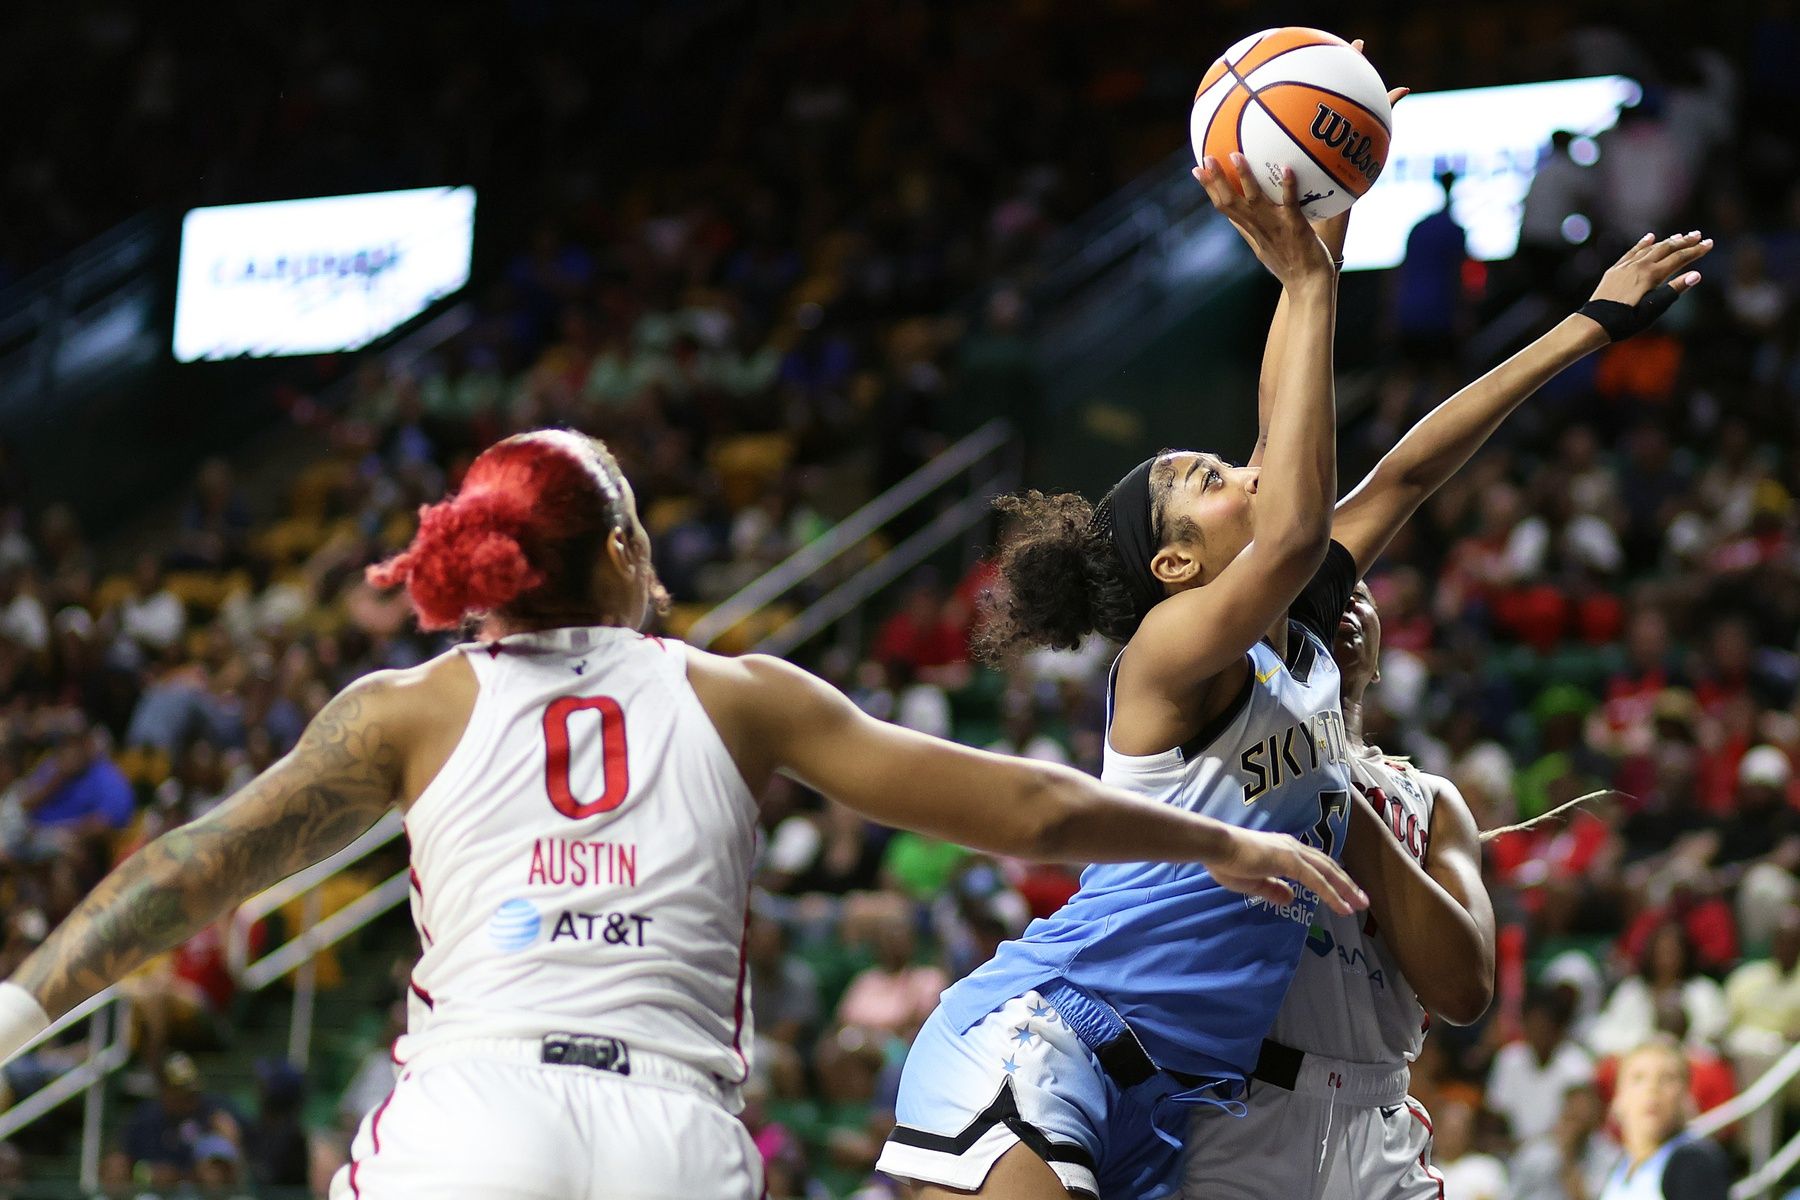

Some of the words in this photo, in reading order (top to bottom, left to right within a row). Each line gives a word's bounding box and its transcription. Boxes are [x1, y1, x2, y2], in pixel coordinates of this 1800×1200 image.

[543, 695, 630, 820] 0
[528, 837, 637, 888] AUSTIN
[550, 911, 653, 947] AT&T
